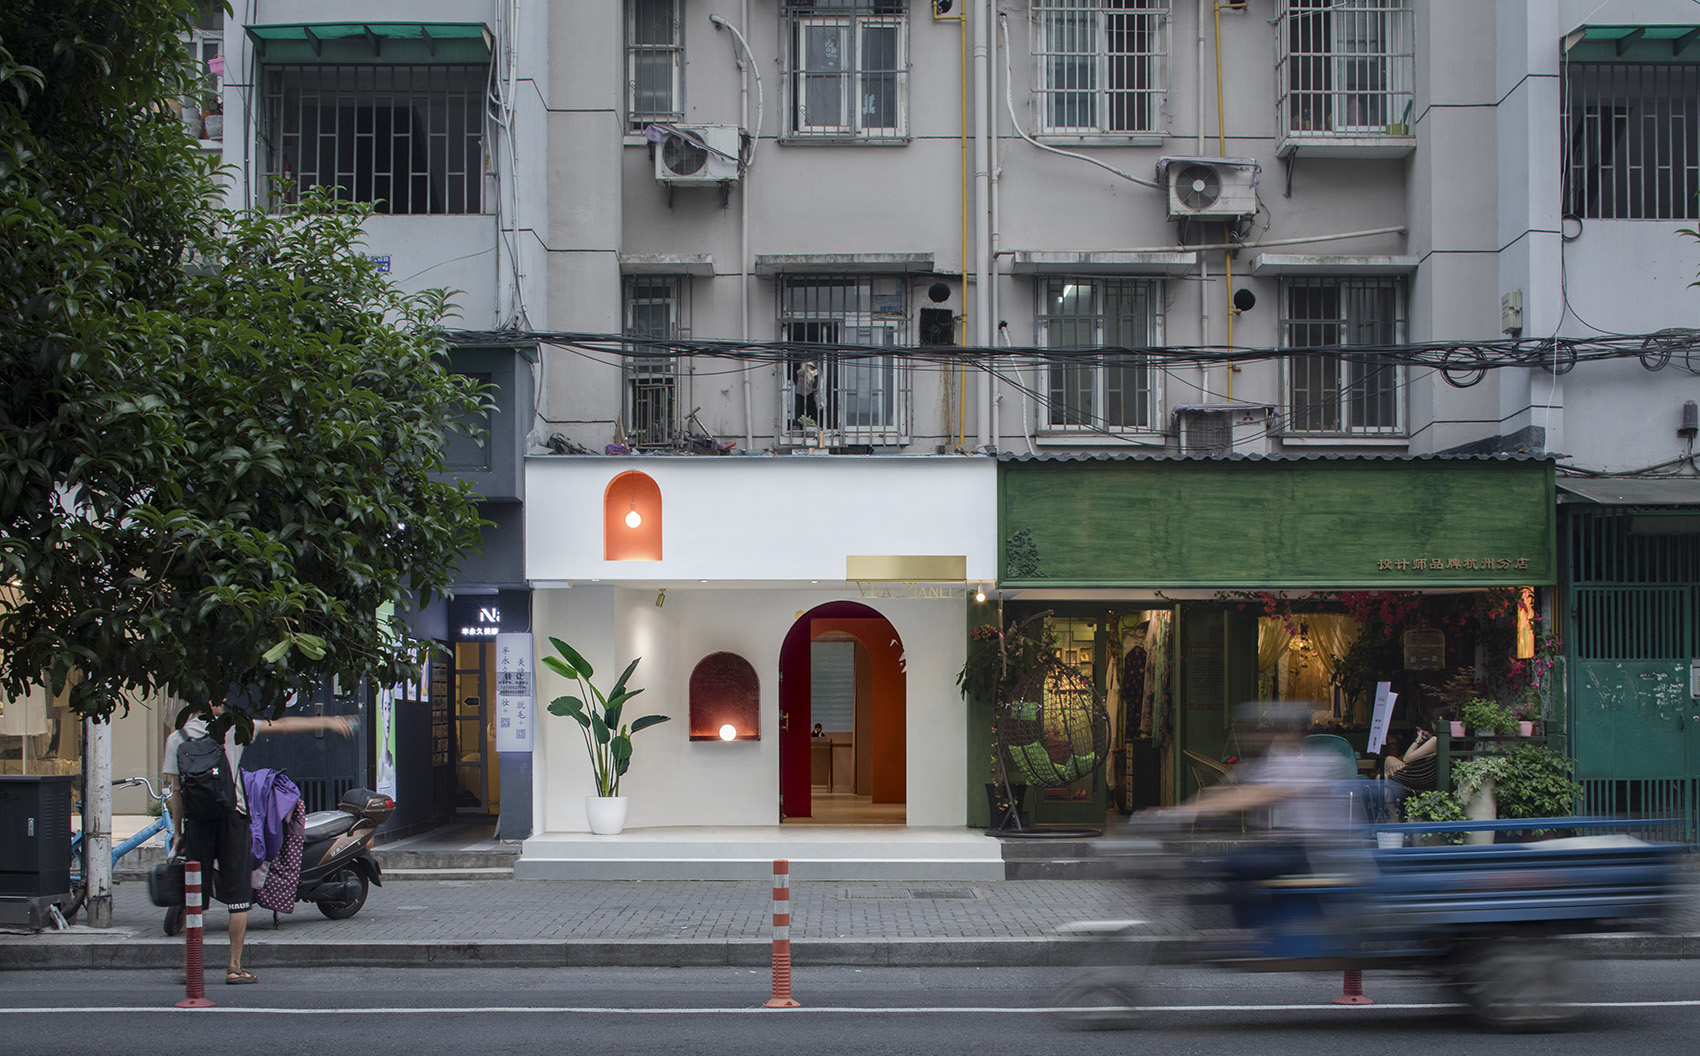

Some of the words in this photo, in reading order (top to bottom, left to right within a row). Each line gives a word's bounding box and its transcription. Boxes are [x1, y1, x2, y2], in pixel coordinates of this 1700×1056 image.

[1377, 557, 1530, 571] 设计师品牌杭州分店
[228, 902, 250, 910] HAUS
